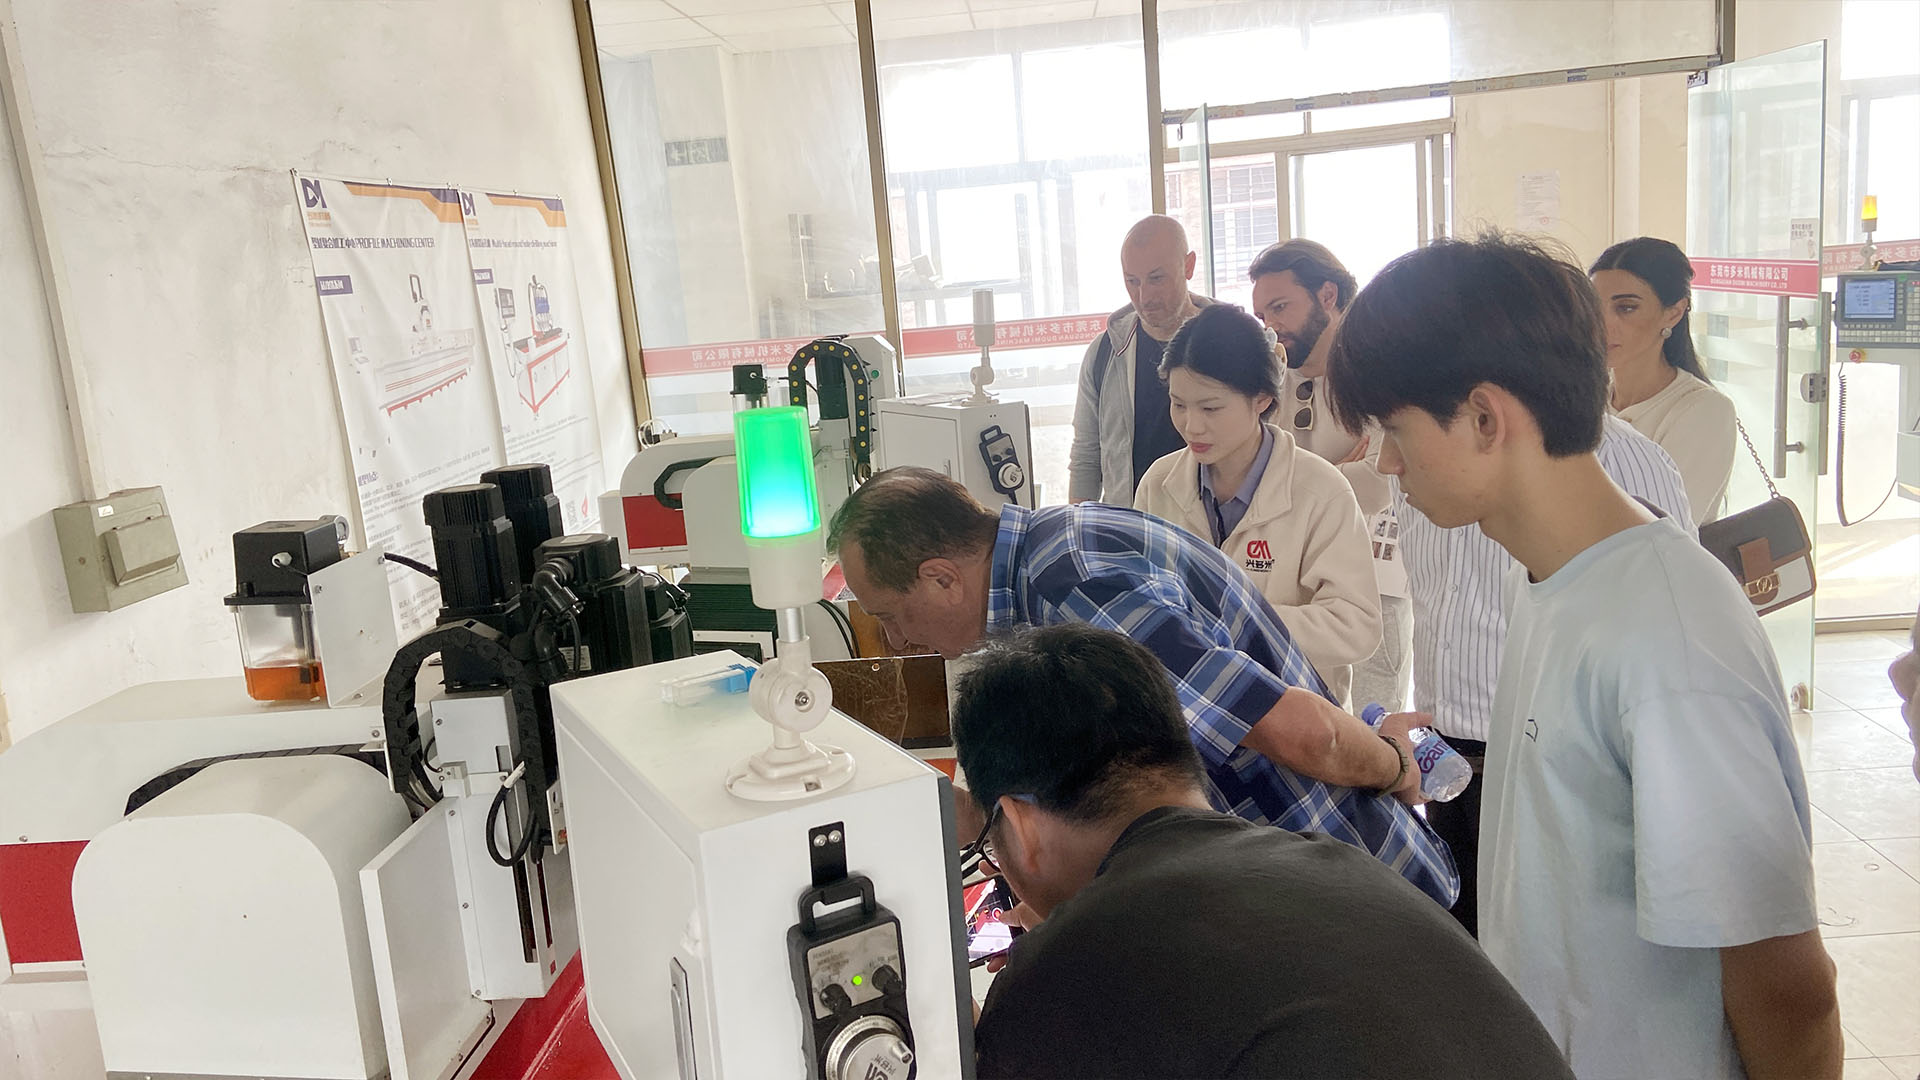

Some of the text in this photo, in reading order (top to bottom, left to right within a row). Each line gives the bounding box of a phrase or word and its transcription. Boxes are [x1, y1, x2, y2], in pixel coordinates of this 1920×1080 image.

[1710, 264, 1789, 281] 东莞市多米机械有限公司
